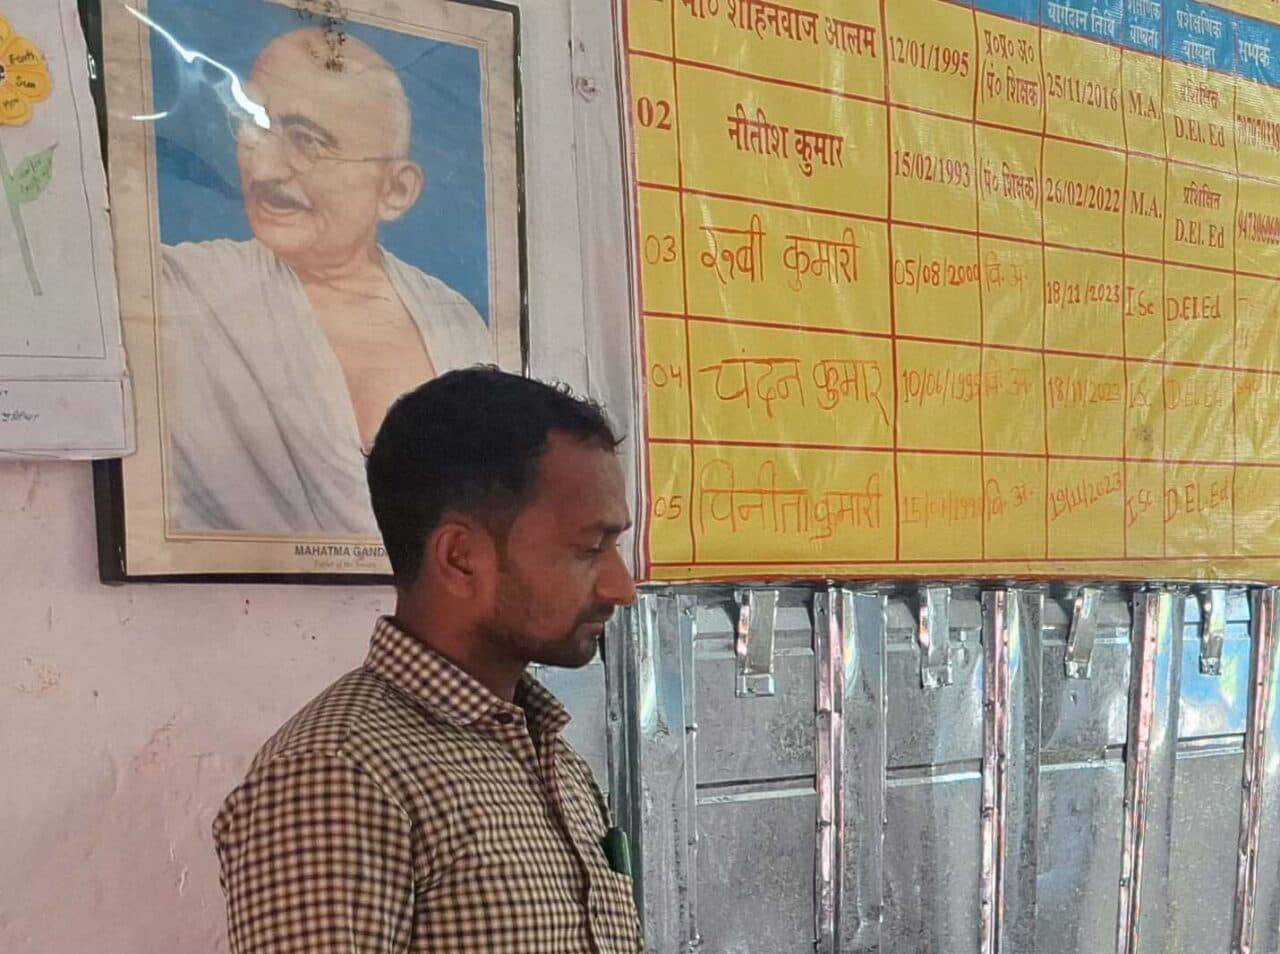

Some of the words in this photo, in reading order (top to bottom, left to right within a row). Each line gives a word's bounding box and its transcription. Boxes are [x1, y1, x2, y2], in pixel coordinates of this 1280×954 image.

[825, 16, 877, 58] आलम
[889, 35, 970, 78] 12/01/1995
[1047, 71, 1118, 113] 25/11/2016
[1128, 89, 1161, 120] M.A.
[637, 96, 672, 130] 02
[727, 102, 789, 158] नीतीश
[794, 128, 844, 177] कुमार
[894, 149, 971, 188] 15/02/1993
[1047, 177, 1121, 213] 26/02/2022
[1131, 190, 1162, 219] M.A.
[644, 234, 677, 265] 03
[783, 227, 861, 291] कुमारी
[652, 363, 682, 388] 04
[654, 495, 682, 521] 05
[294, 546, 351, 557] MAHATMA
[353, 547, 387, 558] GAND
